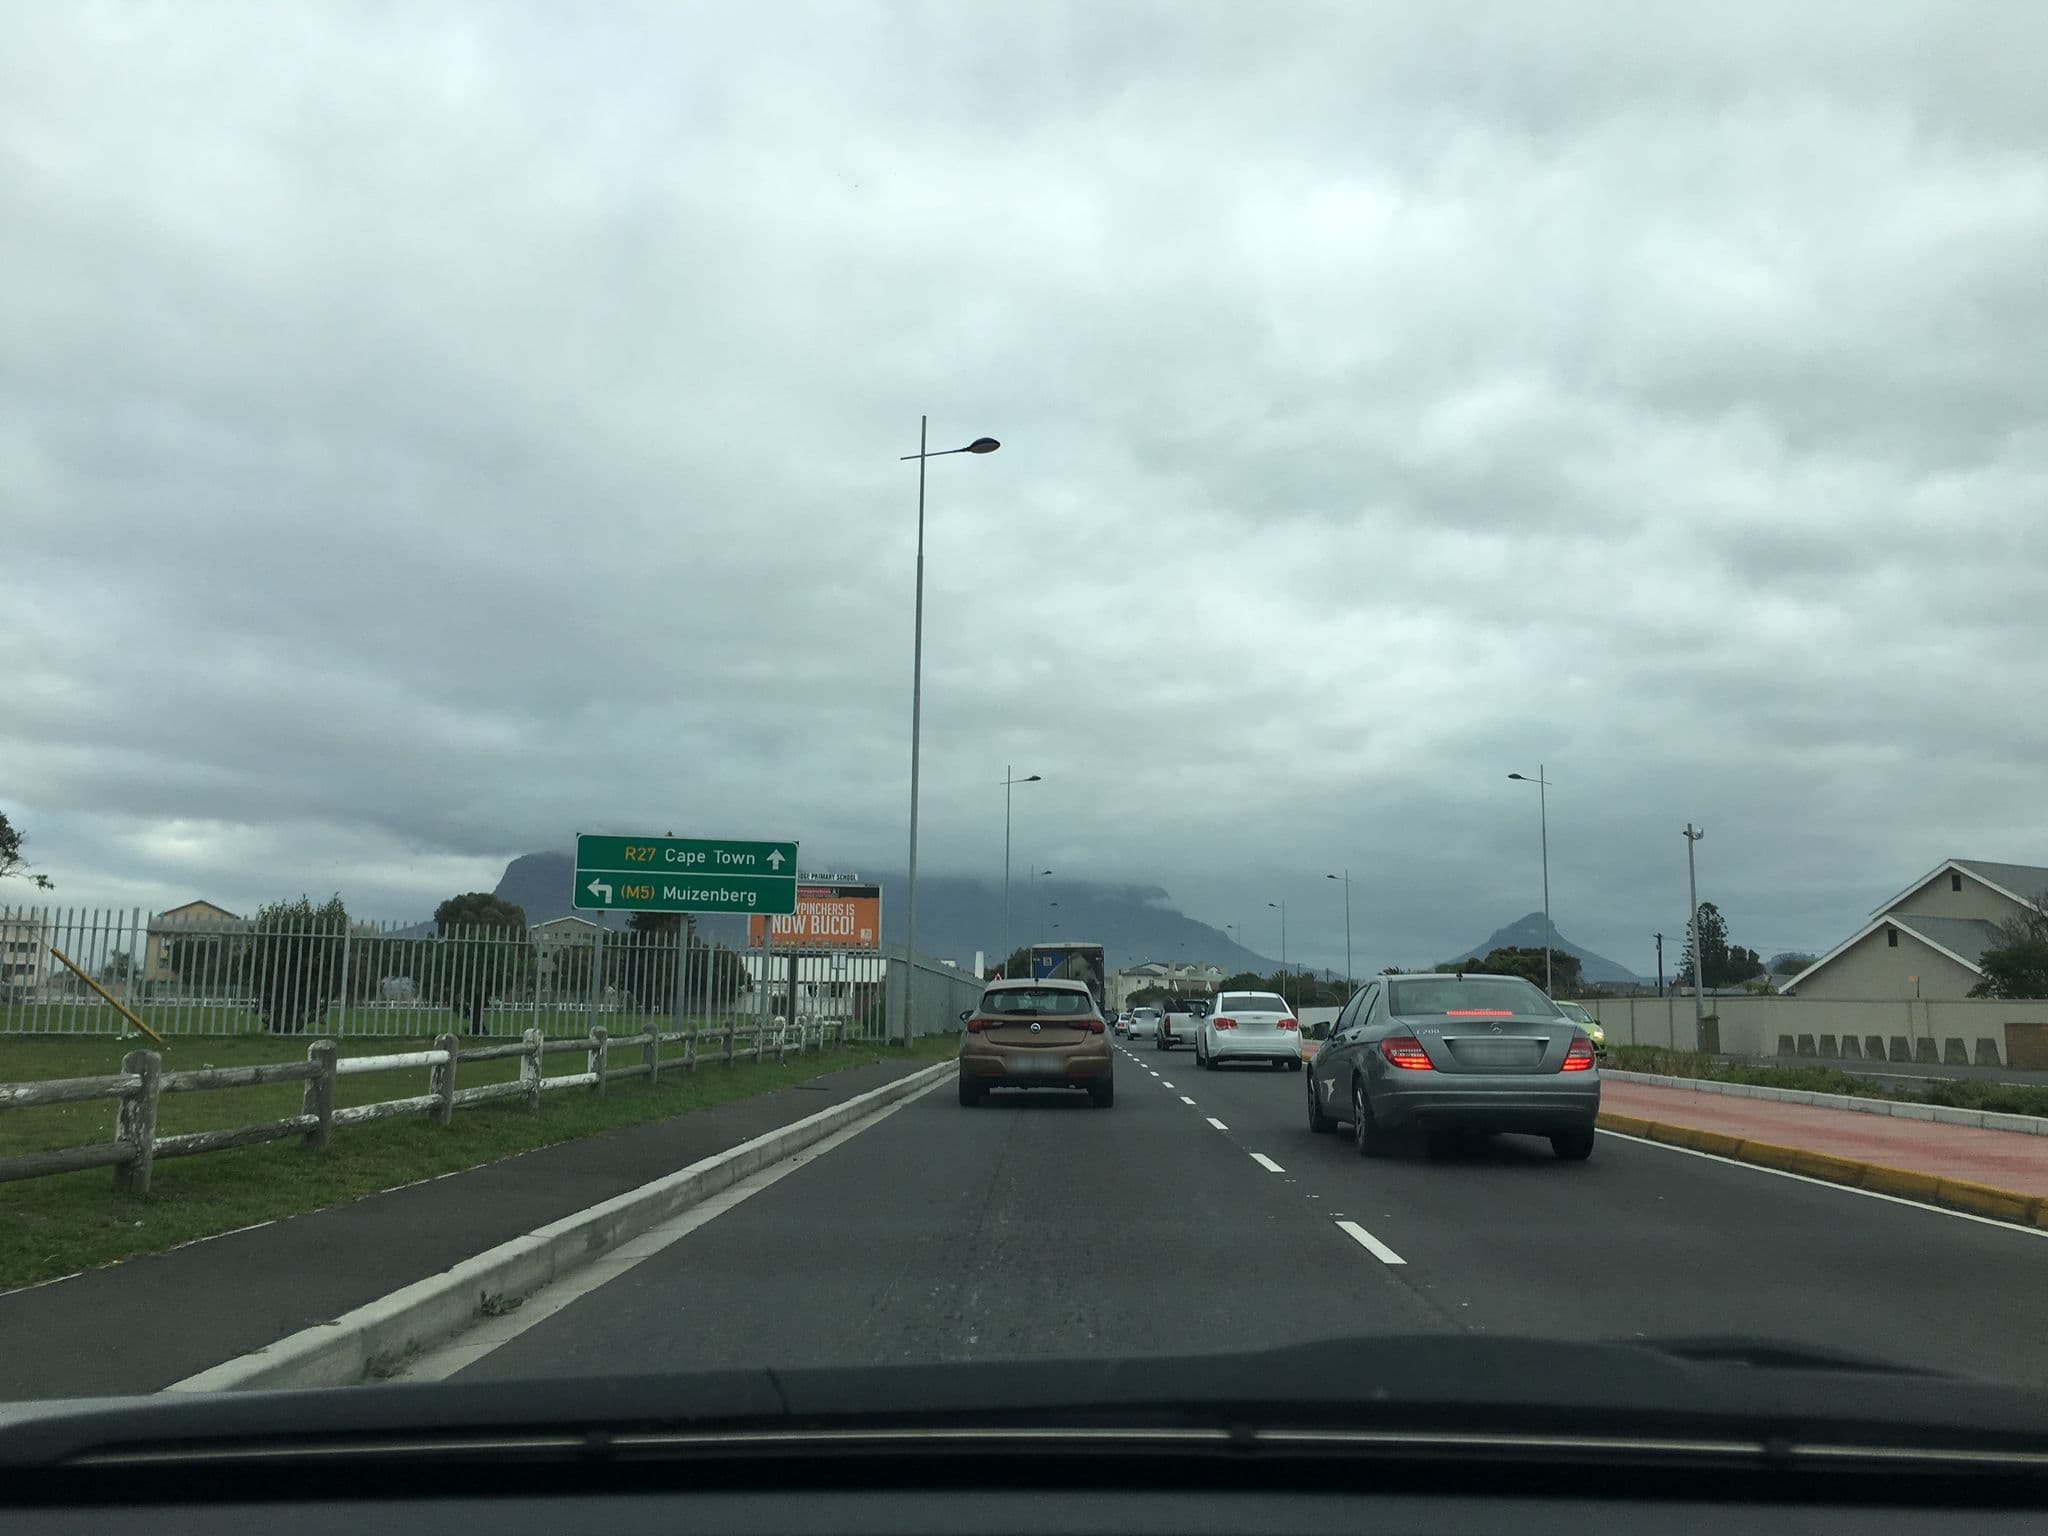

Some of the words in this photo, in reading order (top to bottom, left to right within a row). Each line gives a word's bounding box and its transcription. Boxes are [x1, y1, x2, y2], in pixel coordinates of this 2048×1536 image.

[625, 847, 656, 861] R27
[664, 848, 706, 866] Cape
[713, 850, 756, 865] Town
[811, 872, 835, 881] PRIMARY
[836, 873, 856, 881] SCHOOL
[620, 883, 655, 900] (M5)
[663, 886, 757, 906] Muizenberg
[796, 903, 843, 916] YPINCHERS
[846, 903, 855, 916] IS
[772, 914, 806, 935] NOW
[811, 915, 855, 936] BUCO!
